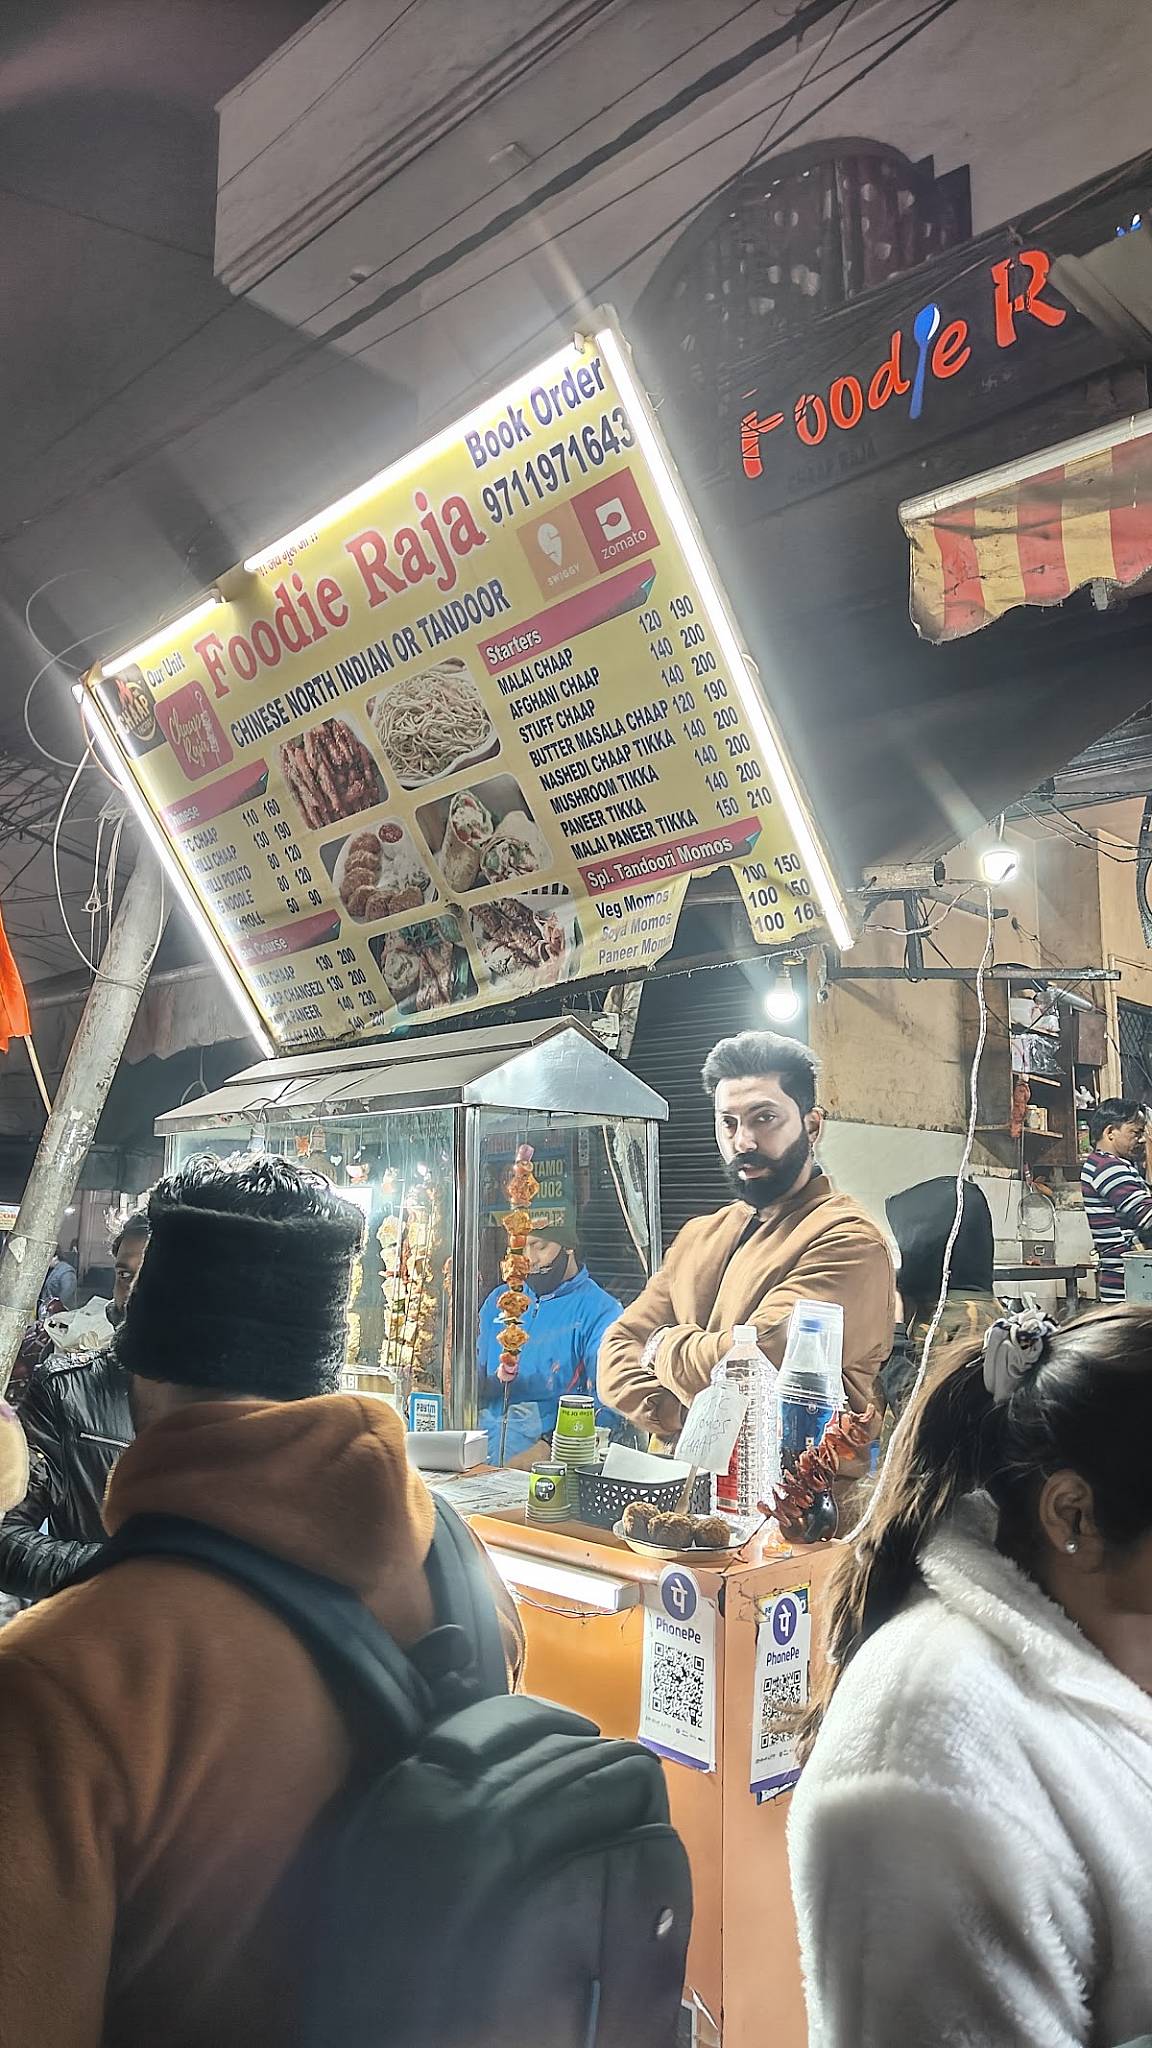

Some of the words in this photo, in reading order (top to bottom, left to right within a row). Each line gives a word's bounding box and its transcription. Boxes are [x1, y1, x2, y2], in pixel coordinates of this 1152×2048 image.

[464, 404, 532, 469] Book
[530, 357, 605, 425] Order
[482, 407, 636, 523] 9711971643
[602, 529, 647, 560] zomato
[194, 573, 349, 699] Foodie
[346, 491, 487, 608] Raja
[547, 561, 580, 586] SWIGGY
[147, 668, 165, 687] Our
[164, 652, 186, 677] Unit
[230, 697, 290, 748] CHINESE
[285, 670, 340, 718] NORTH
[335, 640, 395, 692] INDIAN
[391, 626, 423, 662] OR
[416, 578, 512, 648] TANDOOR
[486, 629, 543, 665] Starters
[497, 666, 535, 696] MALAI
[534, 648, 574, 678] CHAAP
[639, 609, 662, 634] 120
[670, 595, 694, 620] 190
[509, 685, 561, 720] AFGHANI
[560, 666, 600, 698] CHAAP
[650, 637, 674, 661] 140
[680, 623, 705, 648] 200
[518, 715, 555, 744] STUFF
[555, 699, 595, 729] CHAAP
[661, 664, 684, 688] 140
[691, 651, 717, 676] 200
[529, 737, 576, 768] BUTTER
[574, 718, 626, 750] MASALA
[626, 699, 669, 731] CHAAP
[672, 691, 695, 715] 120
[703, 678, 728, 702] 190
[539, 759, 592, 791] NASHEDI
[591, 744, 632, 772] CHAAP
[632, 729, 676, 757] TIKKA
[683, 718, 706, 741] 140
[713, 706, 739, 730] 200
[550, 778, 619, 815] MUSHROOM
[617, 764, 660, 791] TIKKA
[694, 744, 718, 767] 140
[725, 733, 750, 757] 200
[168, 807, 199, 826] hinese
[560, 810, 607, 837] PANEER
[605, 797, 647, 823] TIKKA
[705, 771, 728, 793] 140
[736, 759, 761, 783] 200
[570, 836, 609, 860] MALAI
[607, 821, 657, 849] PANEER
[655, 809, 699, 834] TIKKA
[715, 797, 739, 818] 150
[747, 786, 772, 809] 210
[193, 827, 218, 850] CHAAP
[242, 809, 259, 827] 110
[263, 799, 280, 818] 160
[193, 853, 213, 873] HILLI
[211, 845, 237, 867] CHAAP
[253, 831, 270, 849] 130
[274, 821, 291, 840] 190
[204, 874, 224, 893] HILLI
[222, 864, 252, 887] POTATO
[267, 853, 280, 869] 80
[285, 844, 301, 862] 120
[587, 871, 615, 889] Spl.
[613, 849, 677, 880] Tandoori
[676, 836, 734, 865] Momos
[596, 898, 623, 919] Veg
[624, 889, 669, 913] Momos
[743, 863, 767, 883] 100
[774, 853, 801, 874] 150
[223, 889, 254, 912] NOODLE
[277, 875, 289, 892] 80
[295, 867, 312, 885] 120
[286, 898, 300, 913] 50
[307, 889, 322, 906] 90
[630, 913, 672, 935] Momos
[748, 886, 778, 908] 100
[784, 878, 811, 897] 150
[253, 937, 289, 956] Course
[599, 946, 638, 965] Paneer
[755, 912, 785, 933] 100
[269, 965, 296, 985] CHAAP
[315, 954, 333, 971] 130
[337, 947, 356, 964] 200
[284, 980, 326, 1003] CHANGEZI
[327, 975, 344, 992] 130
[348, 968, 366, 985] 200
[290, 1003, 323, 1023] PANEER
[338, 996, 354, 1011] 140
[359, 990, 376, 1006] 230
[349, 1016, 365, 1031] 140
[656, 1617, 701, 1644] PhonePe
[766, 1647, 800, 1667] PhonePe
